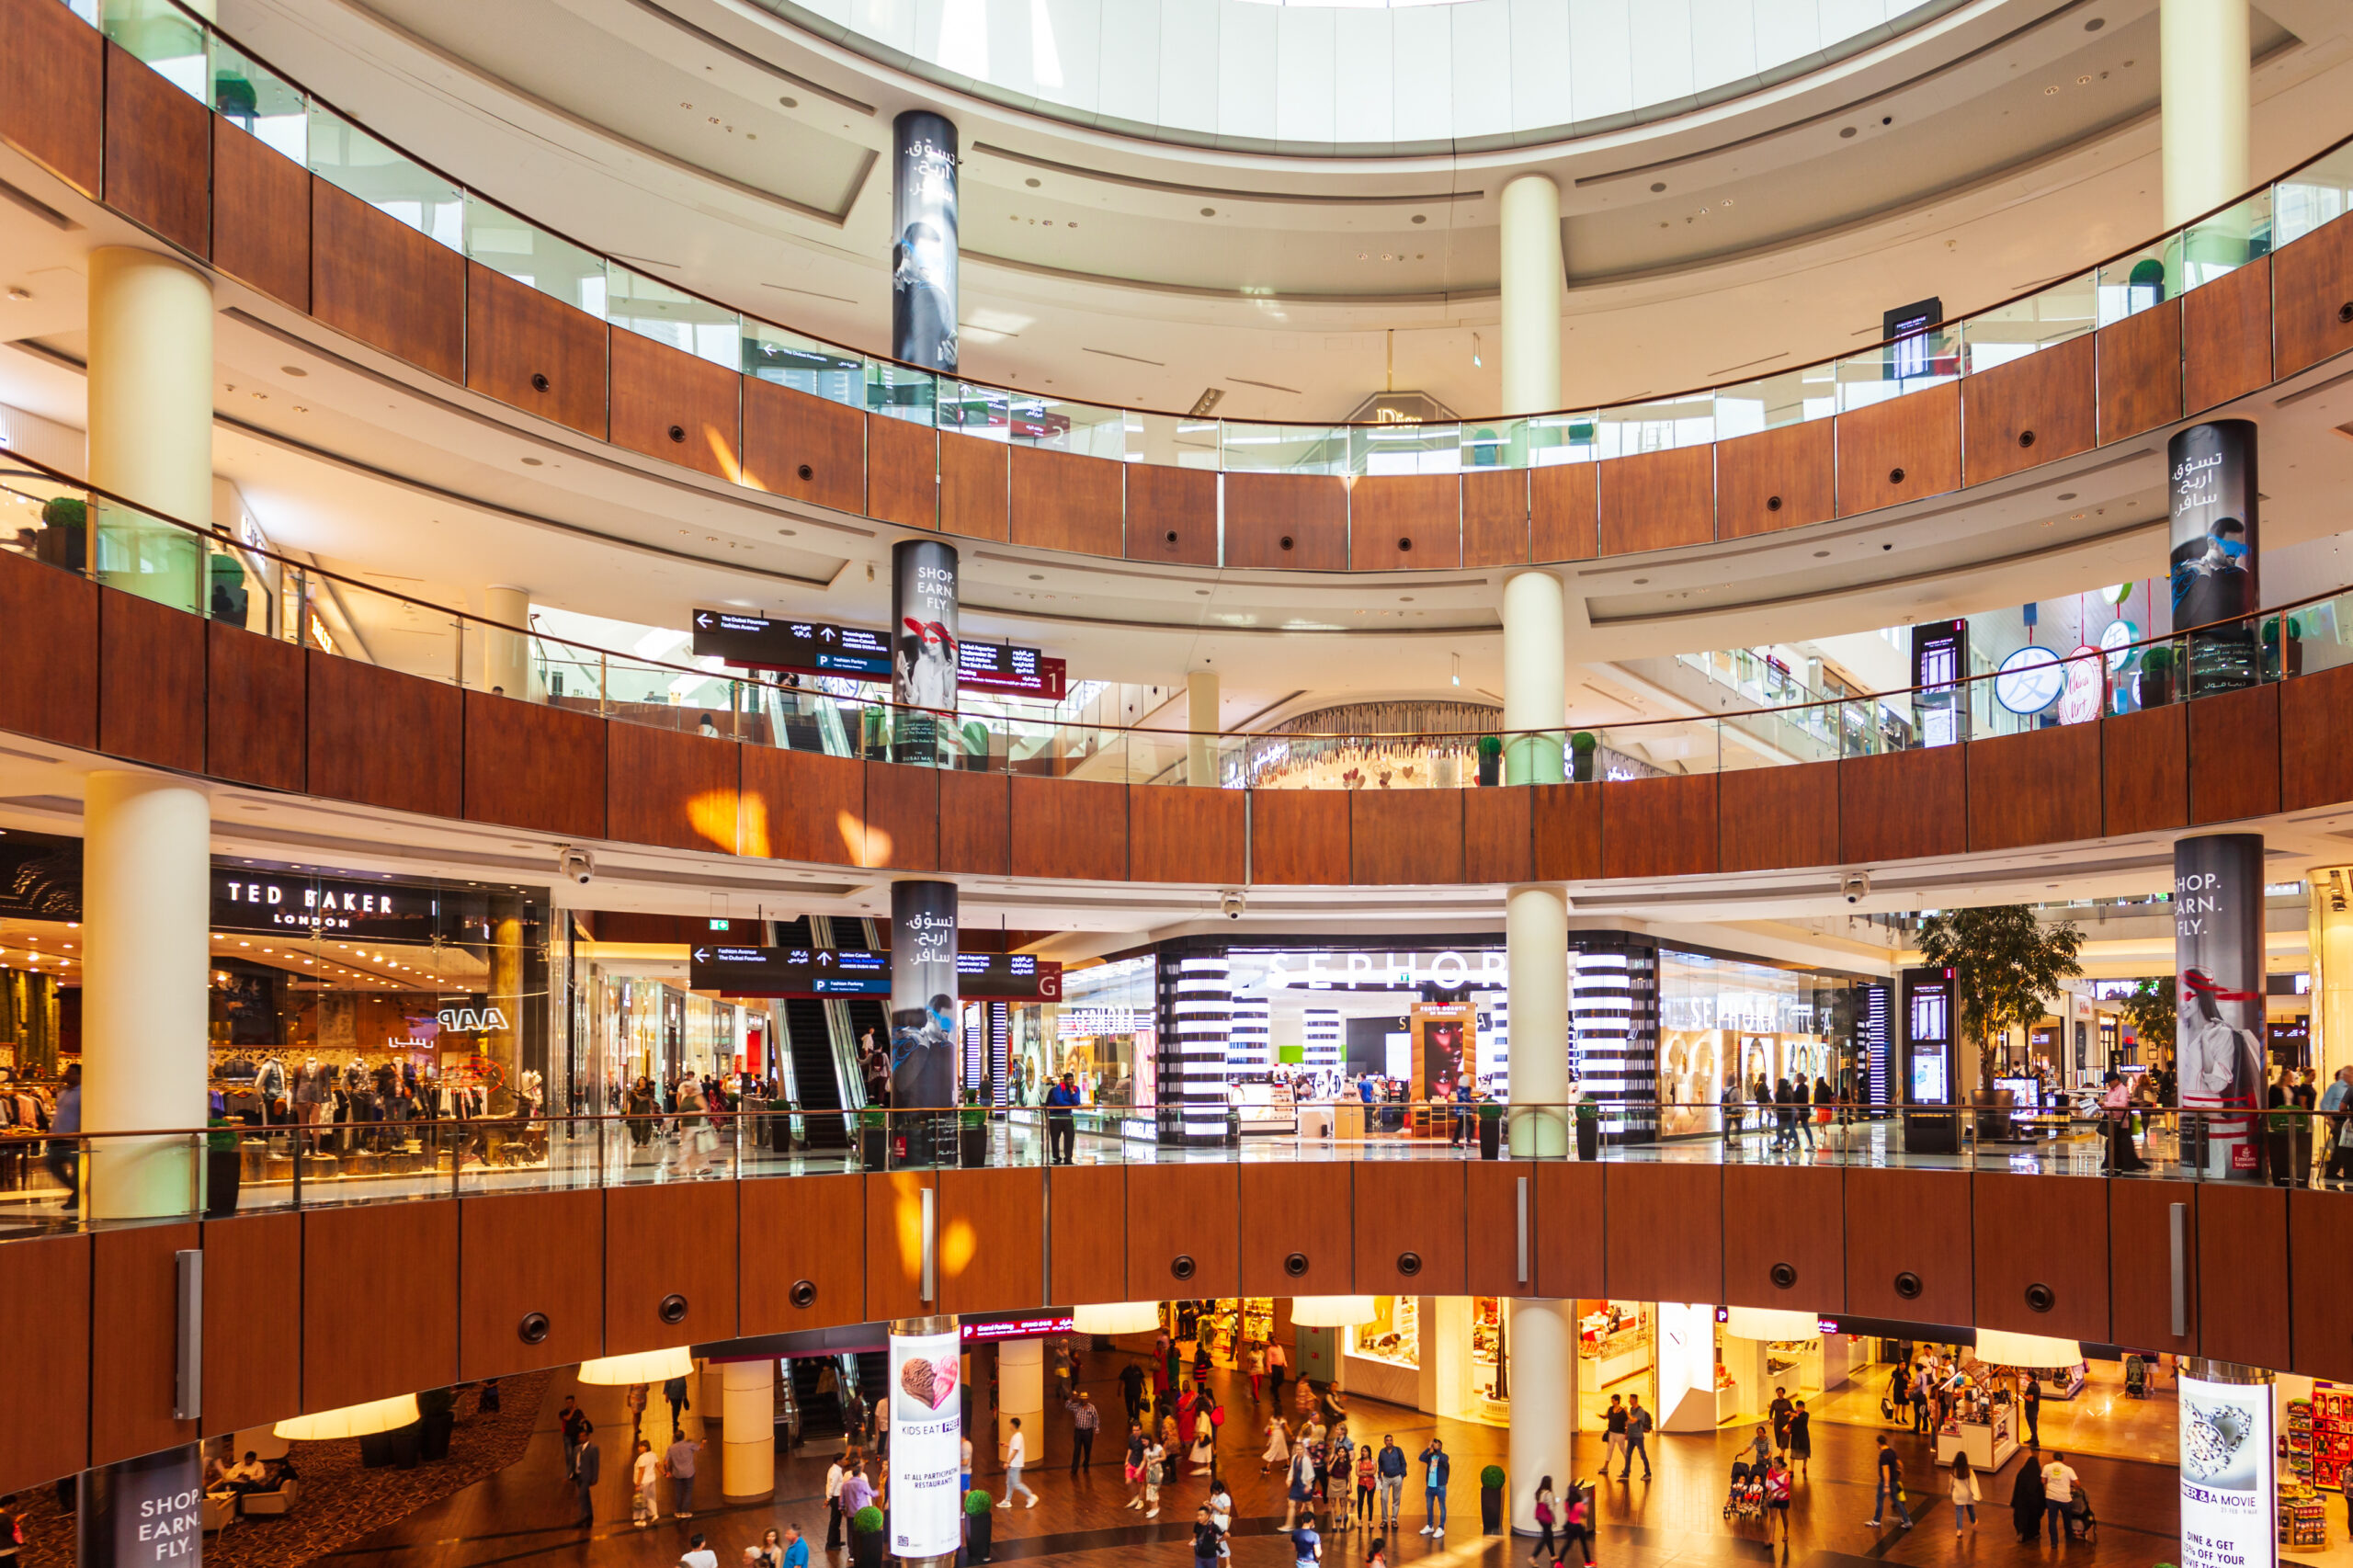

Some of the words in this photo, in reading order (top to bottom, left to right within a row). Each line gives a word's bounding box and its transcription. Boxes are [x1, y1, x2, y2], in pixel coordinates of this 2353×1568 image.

[1376, 408, 1424, 429] Dior
[1052, 426, 1064, 446] 2
[2177, 469, 2212, 494] اربح.
[2175, 493, 2217, 517] سافر.
[918, 566, 955, 585] SHOP.
[917, 582, 955, 599] EARN.
[926, 597, 949, 612] FLY.
[820, 655, 828, 665] P
[1049, 672, 1056, 692] 1
[2003, 652, 2052, 706] 发
[228, 882, 282, 904] TED
[304, 890, 392, 915] BAKER
[274, 914, 349, 928] LONDON
[906, 911, 953, 929] تسوّق.
[2177, 918, 2208, 937] FLY.
[914, 929, 948, 946] اربح.
[910, 948, 950, 965] سافر.
[1267, 950, 1507, 990] SEPHOR
[816, 981, 825, 990] P
[1039, 975, 1056, 996] G
[1718, 1311, 1727, 1322] P
[963, 1325, 972, 1337] P
[902, 1426, 921, 1436] KIDS
[923, 1425, 940, 1435] EAT
[140, 1488, 200, 1517] SHOP.
[2211, 1494, 2218, 1504] A
[2221, 1494, 2256, 1507] MOVIE
[139, 1511, 200, 1541] EARN.
[156, 1536, 193, 1561] FLY.
[2188, 1530, 2203, 1545] DINE
[2206, 1538, 2212, 1548] &
[2216, 1540, 2234, 1551] GET
[2198, 1549, 2213, 1561] OFF
[2217, 1552, 2245, 1565] YOUR
